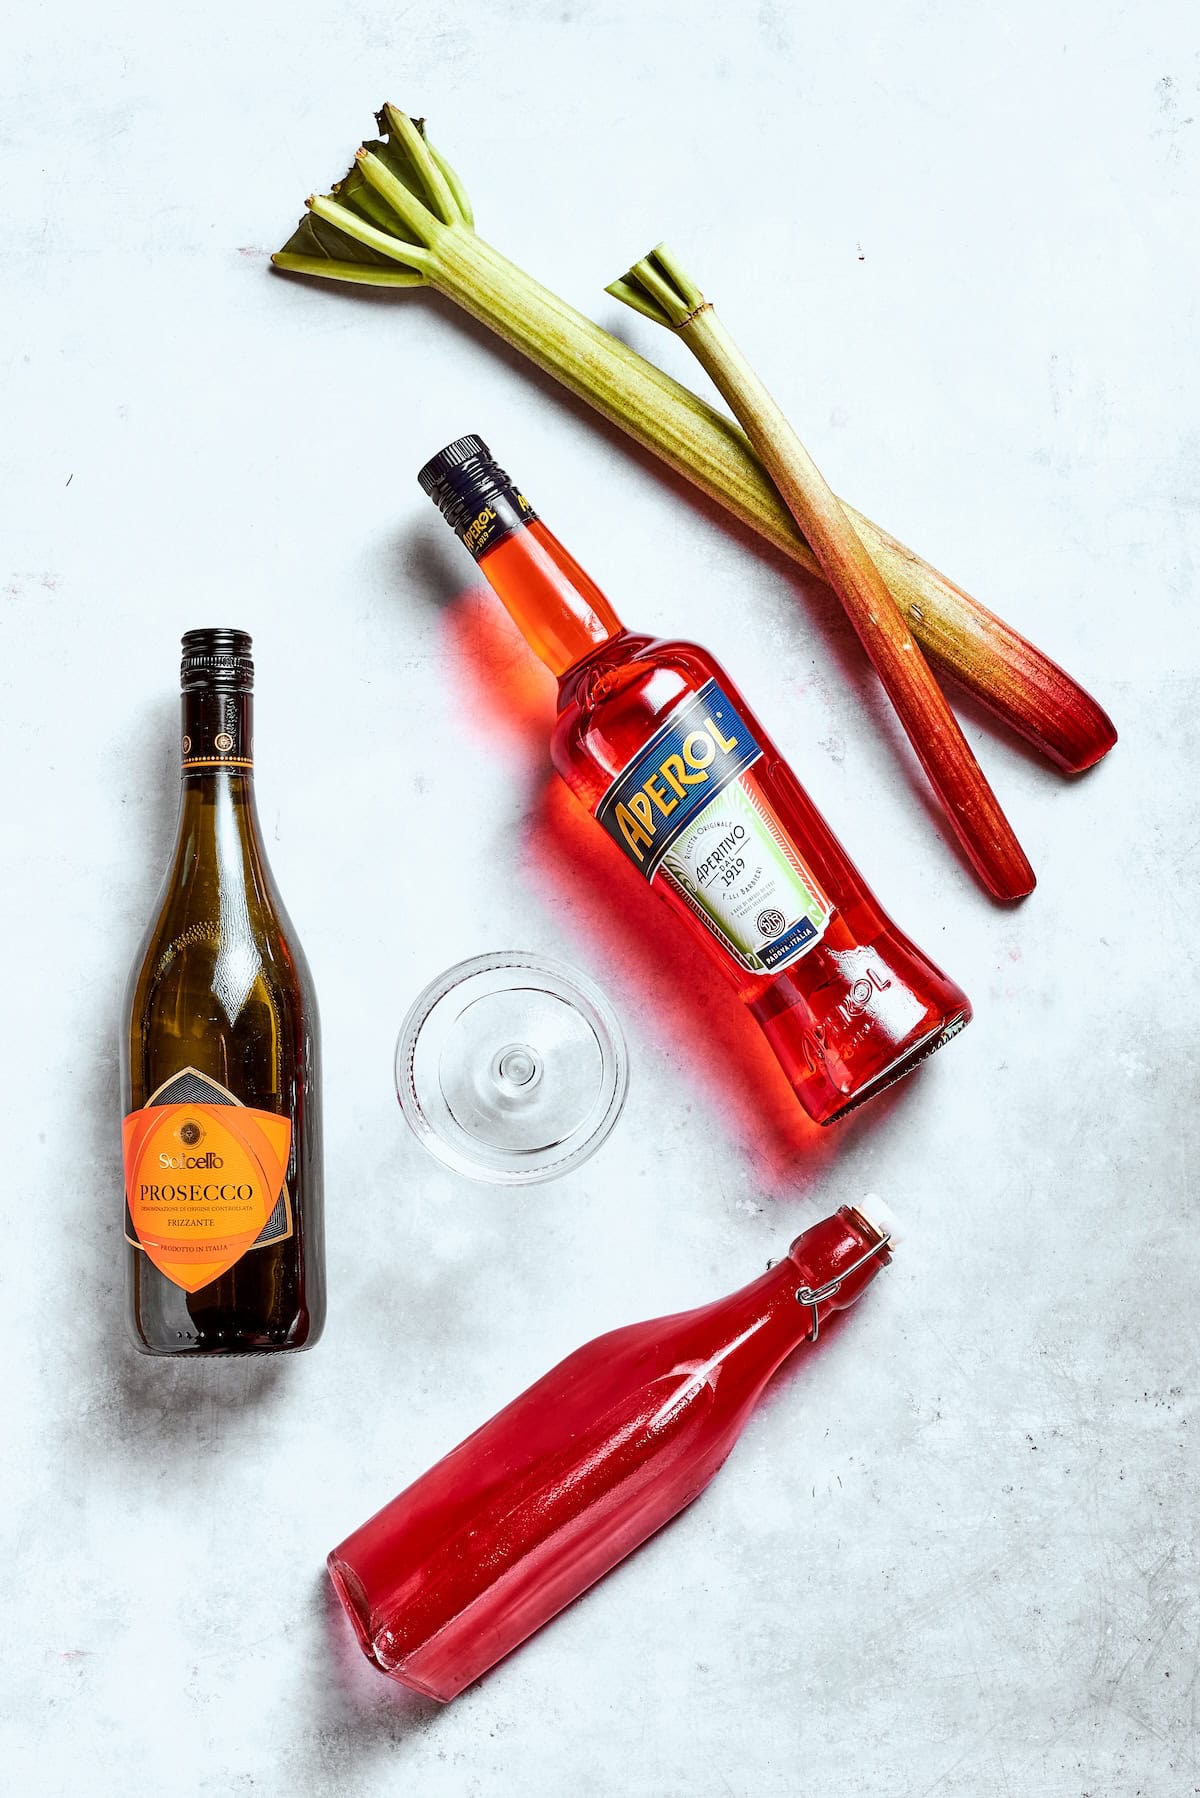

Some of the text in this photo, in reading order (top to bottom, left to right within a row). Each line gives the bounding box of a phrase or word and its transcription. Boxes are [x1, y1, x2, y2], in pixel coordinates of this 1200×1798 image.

[463, 507, 497, 552] APEROL
[477, 531, 490, 548] 1919
[614, 717, 738, 862] APEROL
[697, 821, 732, 835] ORIGINALE
[696, 825, 745, 884] APERITIVO
[719, 856, 735, 872] DAL
[721, 858, 745, 887] 1919
[740, 867, 763, 895] BARBIERI
[140, 1184, 253, 1202] PROSECCO
[167, 1219, 215, 1227] FRIZZANTE
[160, 1244, 195, 1253] PRODOTTO
[205, 1244, 228, 1252] ITALIA
